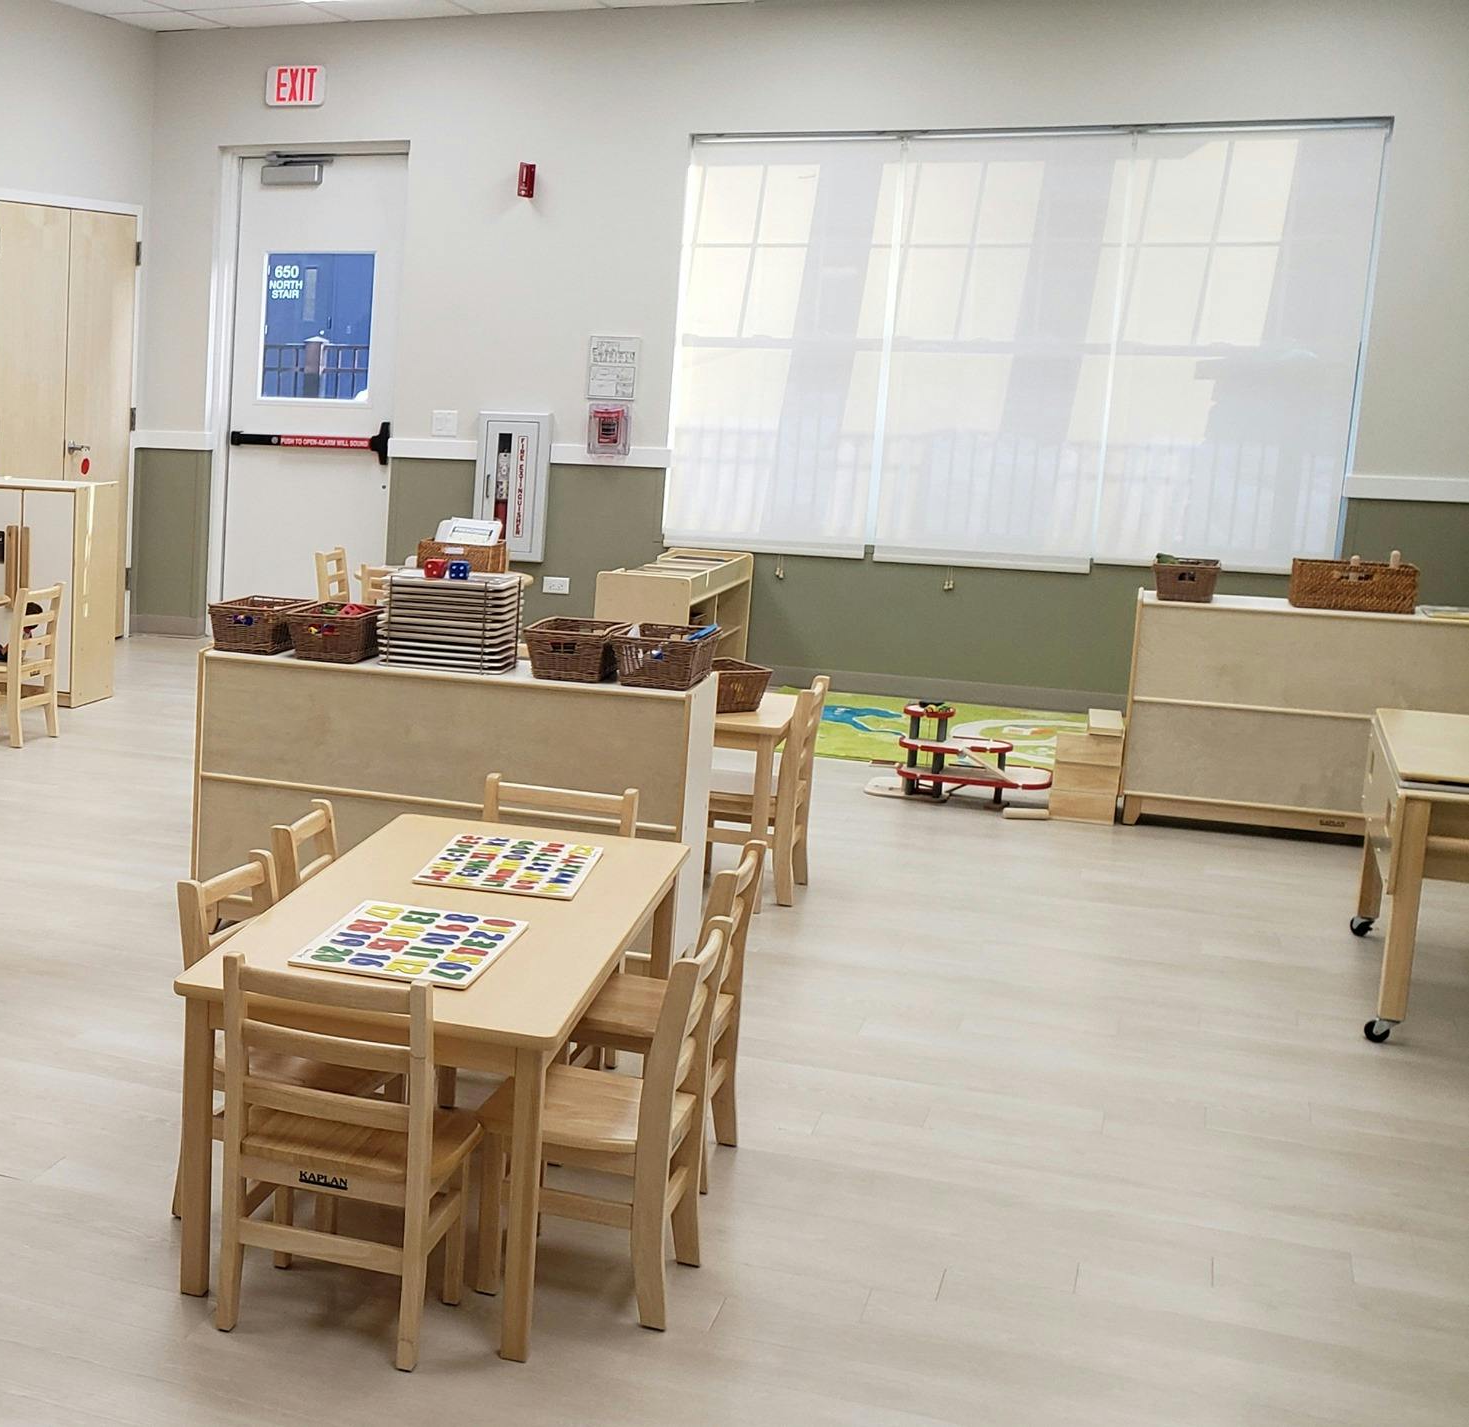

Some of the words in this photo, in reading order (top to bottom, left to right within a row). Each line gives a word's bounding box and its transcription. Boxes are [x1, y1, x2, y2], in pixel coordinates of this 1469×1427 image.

[275, 68, 317, 102] EXIT
[274, 265, 299, 279] 650
[269, 280, 303, 290] NORTH
[272, 290, 300, 299] STAIR
[364, 905, 405, 920] 17
[400, 910, 440, 924] 13
[444, 913, 480, 924] 8
[346, 919, 388, 933] 18
[434, 924, 470, 932] 9
[476, 925, 511, 934] 1
[483, 918, 516, 928] 0
[382, 924, 426, 938] 14
[468, 930, 505, 941] 2
[330, 932, 372, 947] 19
[366, 938, 410, 952] 15
[421, 932, 460, 946] 10
[461, 938, 498, 948] 3
[310, 946, 354, 962] 20
[402, 946, 444, 959] 11
[451, 946, 489, 956] 4
[348, 952, 391, 968] 16
[384, 958, 430, 974] 12
[443, 953, 483, 966] 5
[436, 962, 472, 972] 6
[429, 969, 468, 980] 7
[299, 1170, 348, 1189] KAPLAN
